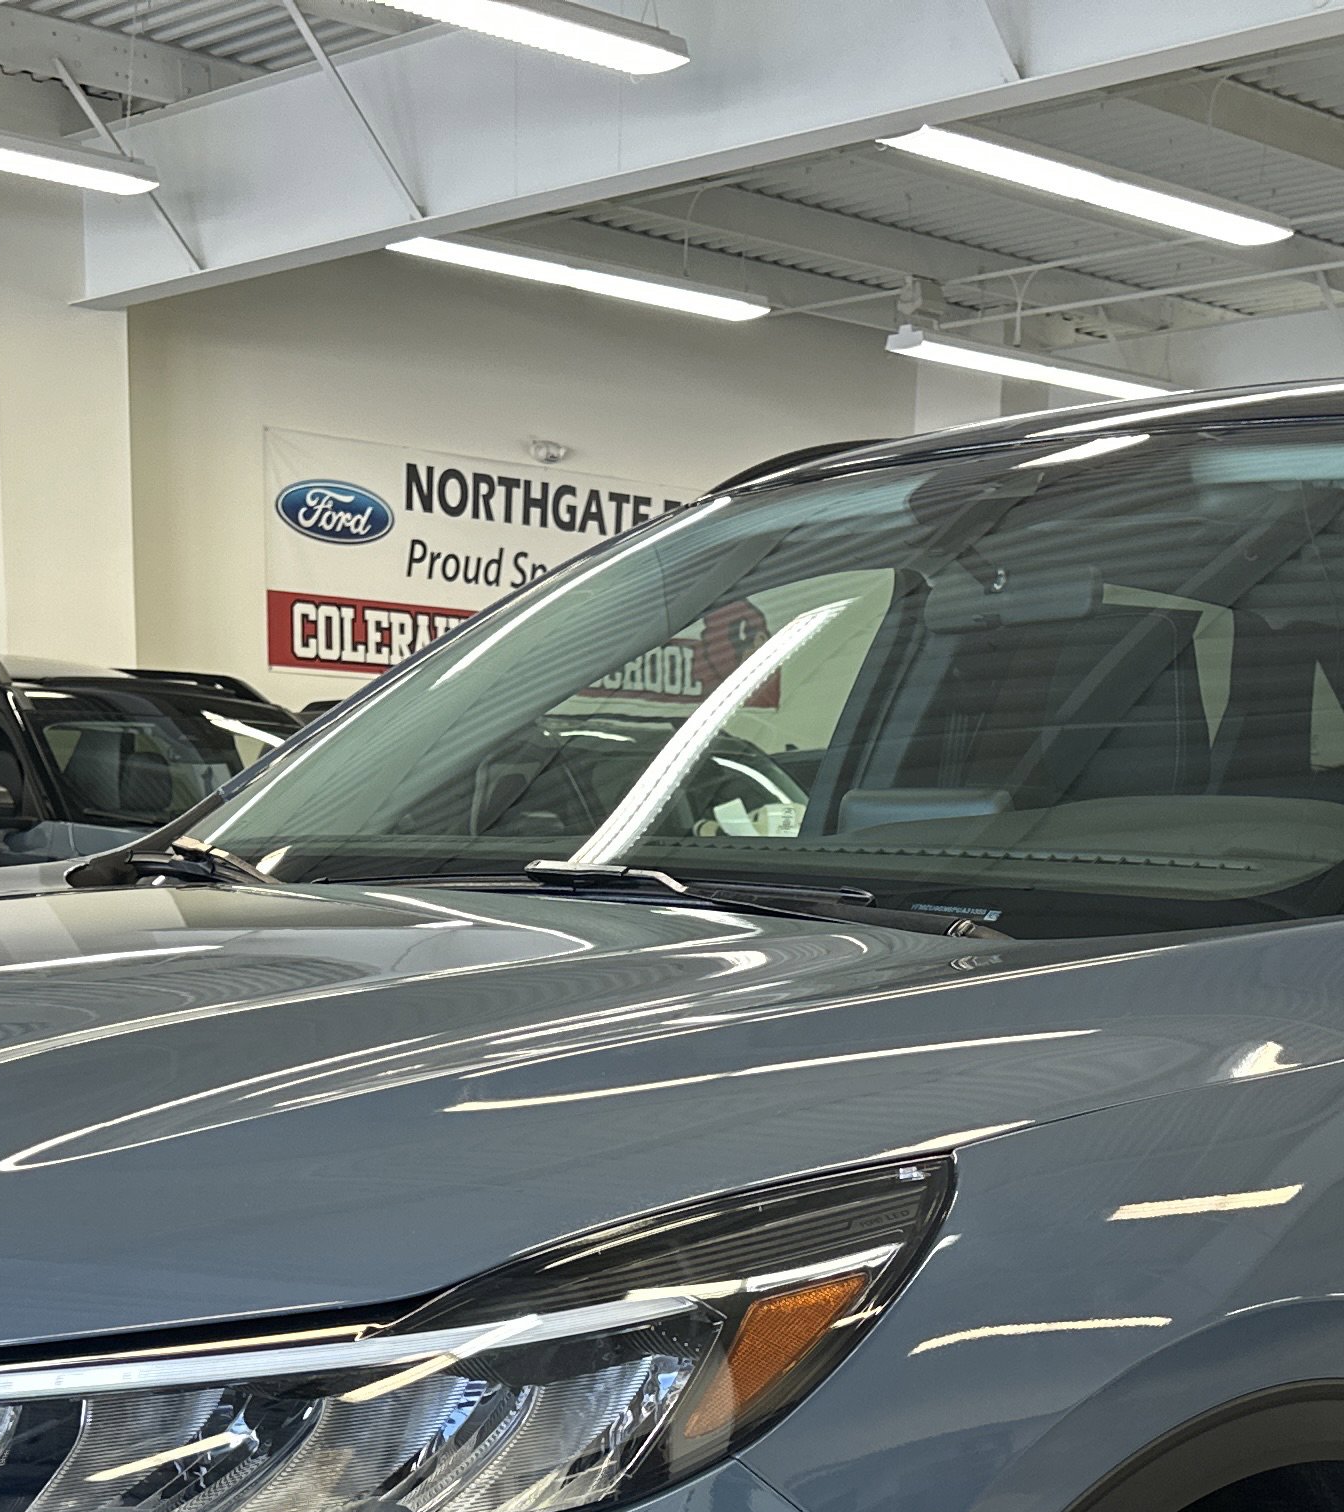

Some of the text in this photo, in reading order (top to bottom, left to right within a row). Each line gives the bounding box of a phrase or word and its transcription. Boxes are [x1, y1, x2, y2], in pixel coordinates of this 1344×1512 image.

[297, 488, 374, 536] Ford
[406, 538, 505, 588] Proud
[292, 602, 468, 665] COLERA
